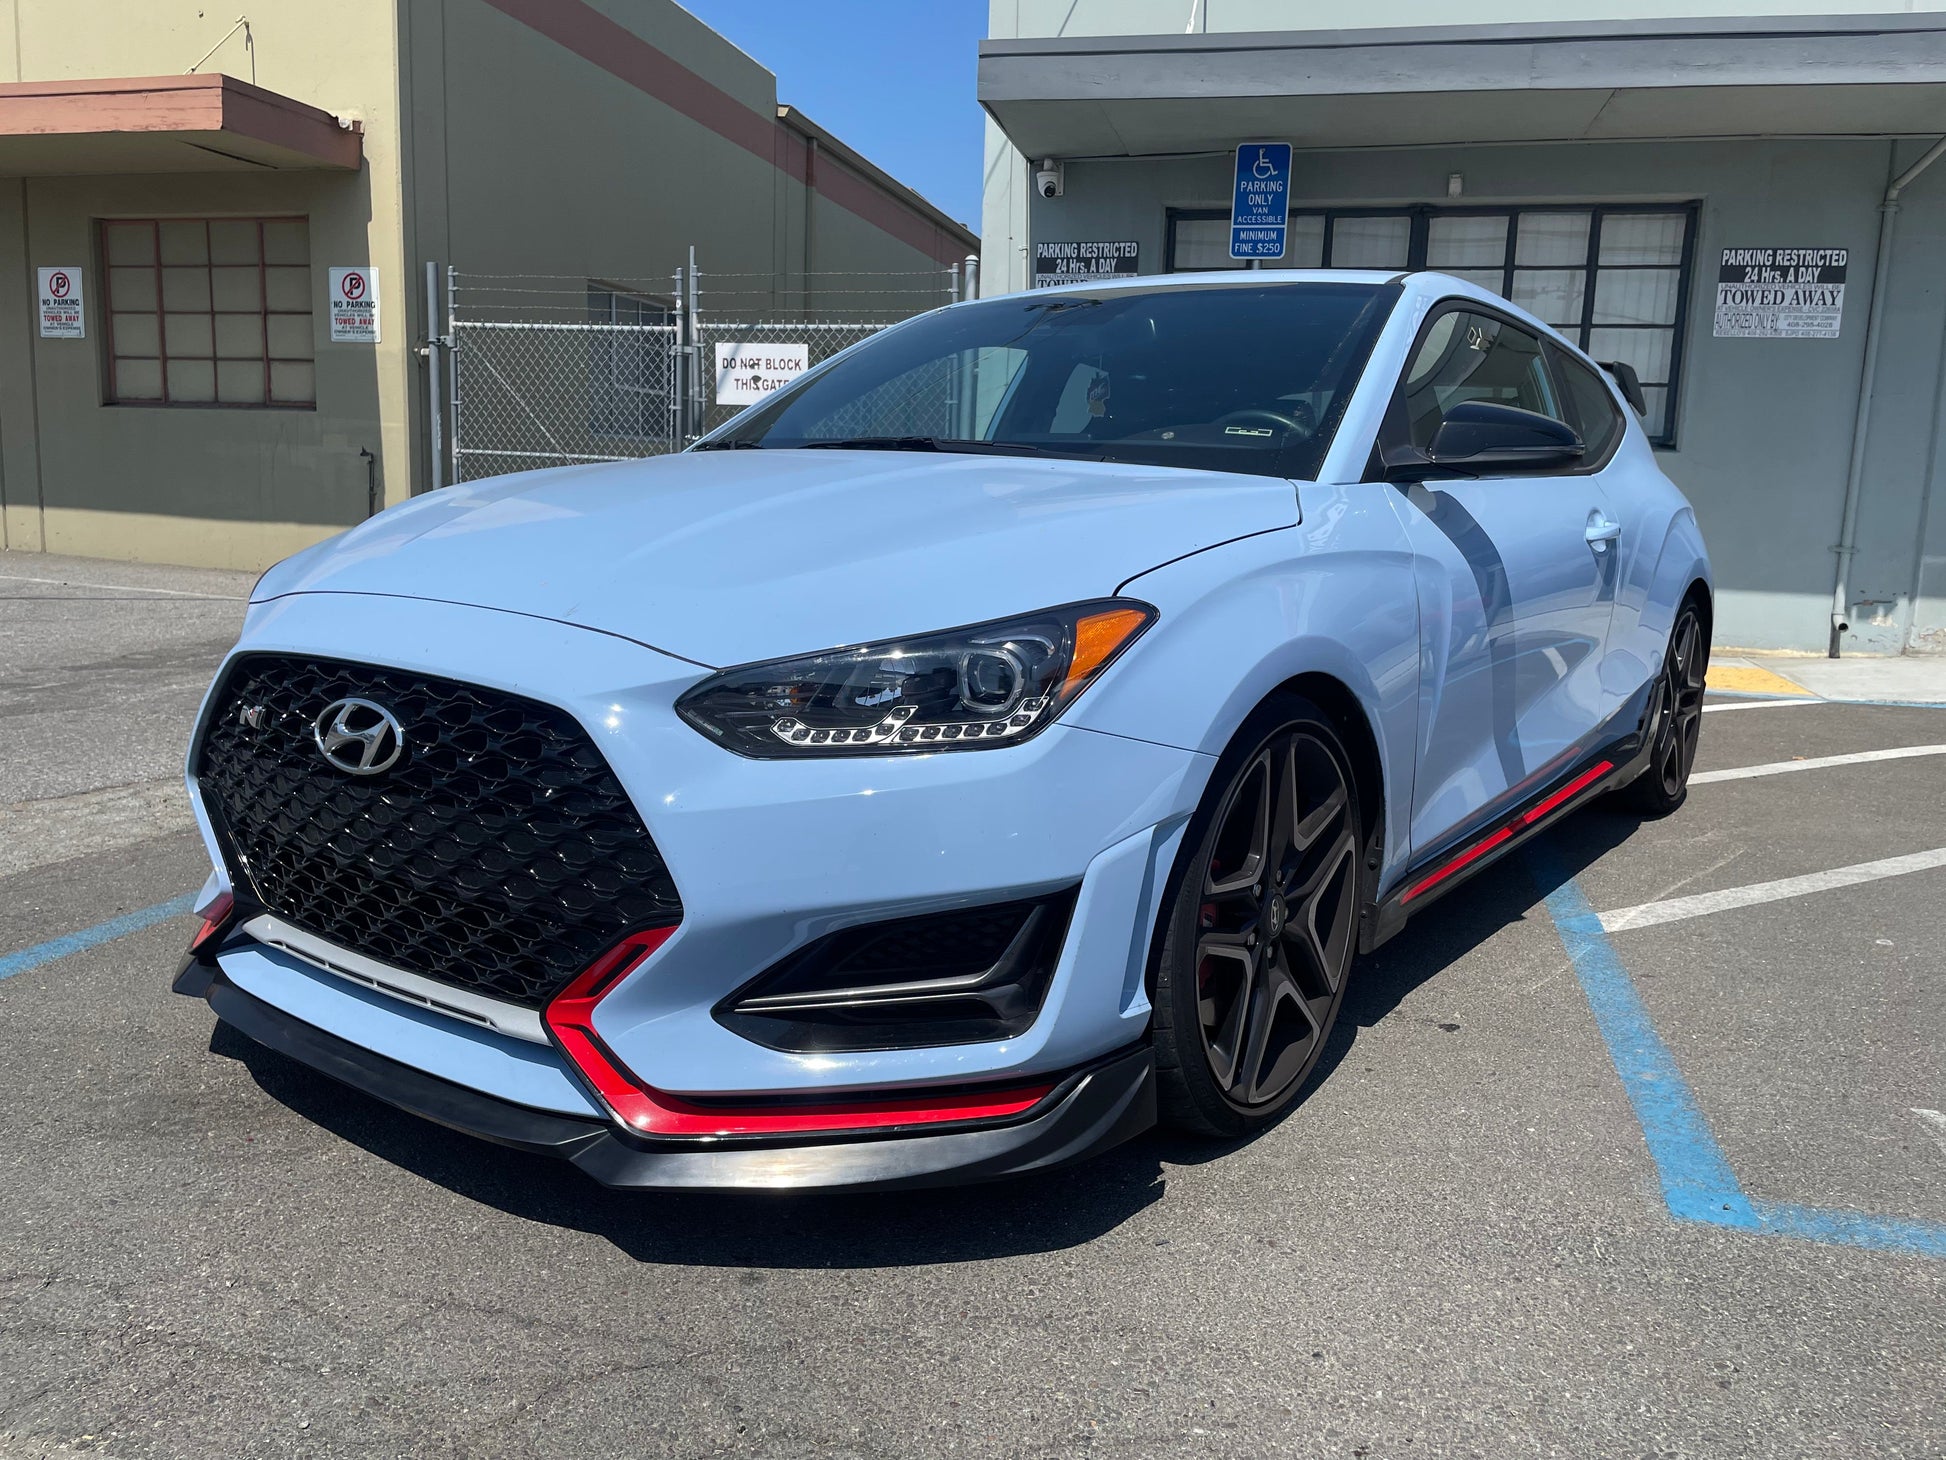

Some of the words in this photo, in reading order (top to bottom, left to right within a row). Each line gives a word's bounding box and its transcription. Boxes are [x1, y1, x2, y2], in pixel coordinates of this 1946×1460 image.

[1240, 181, 1283, 192] PARKING
[1248, 194, 1274, 205] ONLY
[1240, 230, 1277, 240] MINIMUM
[1037, 243, 1078, 258] PARKING
[1080, 242, 1138, 258] RESTRICTED
[1234, 243, 1253, 253] FINE
[1256, 243, 1280, 253] $250
[1722, 250, 1773, 266] PARKING
[1776, 250, 1847, 266] RESTRICTED
[1056, 258, 1067, 273] 24
[1069, 258, 1088, 273] Hrs.
[1090, 259, 1097, 273] A
[1099, 259, 1117, 273] DAY
[1744, 267, 1758, 283] 24
[1761, 267, 1783, 283] Hrs.
[1786, 268, 1795, 282] A
[1798, 267, 1821, 283] DAY
[1720, 290, 1785, 305] TOWED
[1788, 290, 1841, 305] AWAY
[1716, 313, 1753, 329] AUTHORIZED
[1754, 313, 1770, 329] ONLY
[722, 358, 736, 369] DO
[740, 358, 762, 370] NOT
[766, 358, 802, 370] BLOCK
[734, 379, 760, 390] THIS
